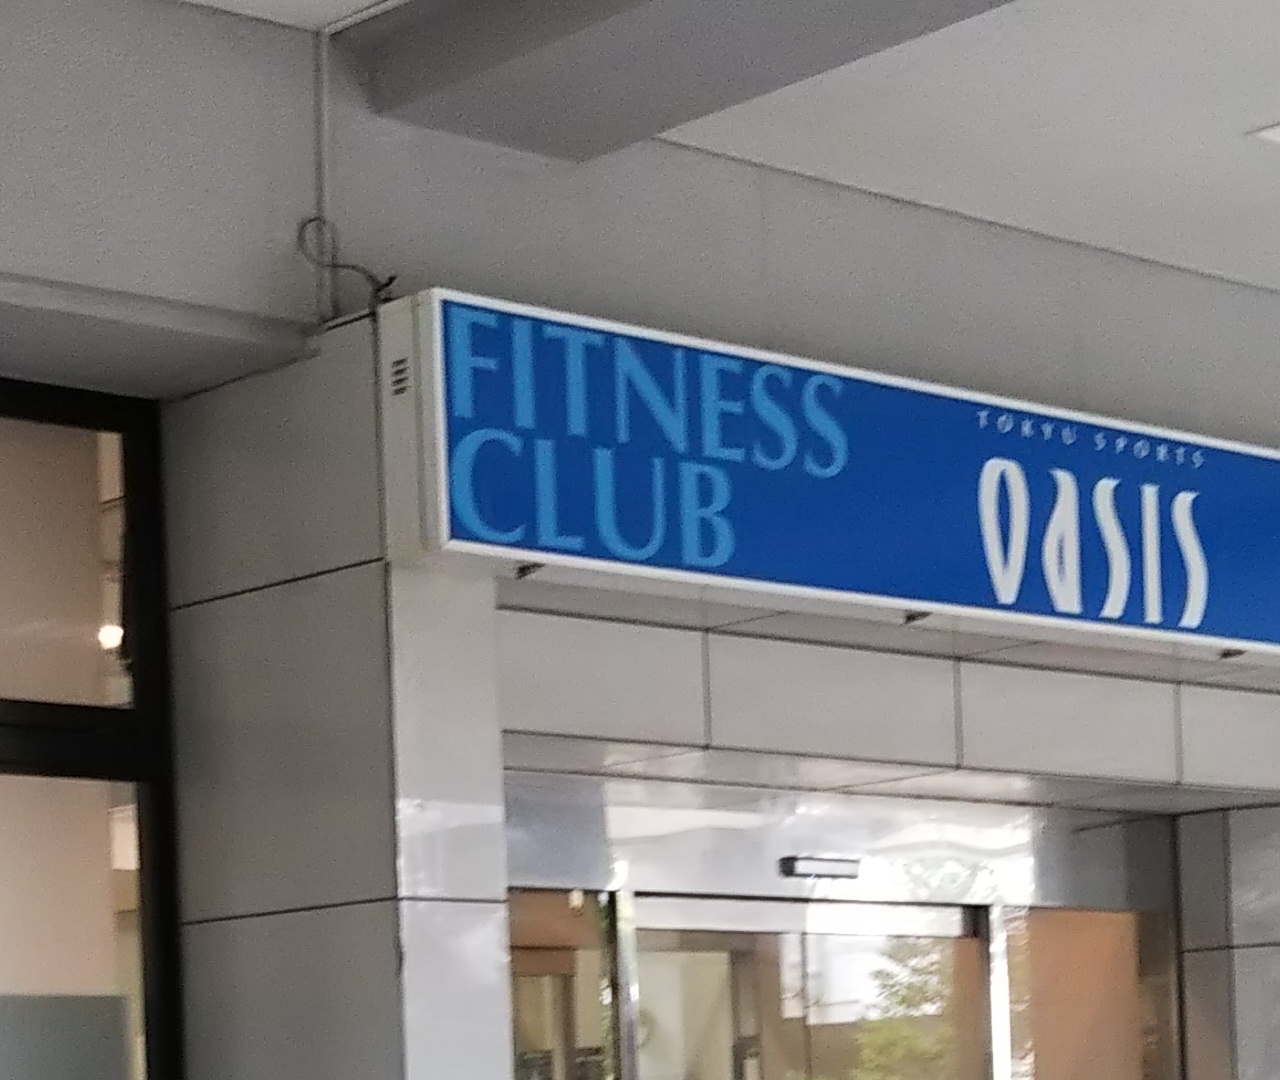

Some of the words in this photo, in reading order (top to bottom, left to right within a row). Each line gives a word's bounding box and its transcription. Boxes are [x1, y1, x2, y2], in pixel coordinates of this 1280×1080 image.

[448, 306, 849, 479] FITNESS
[1093, 431, 1205, 470] SPORTS
[450, 428, 736, 568] CLUB
